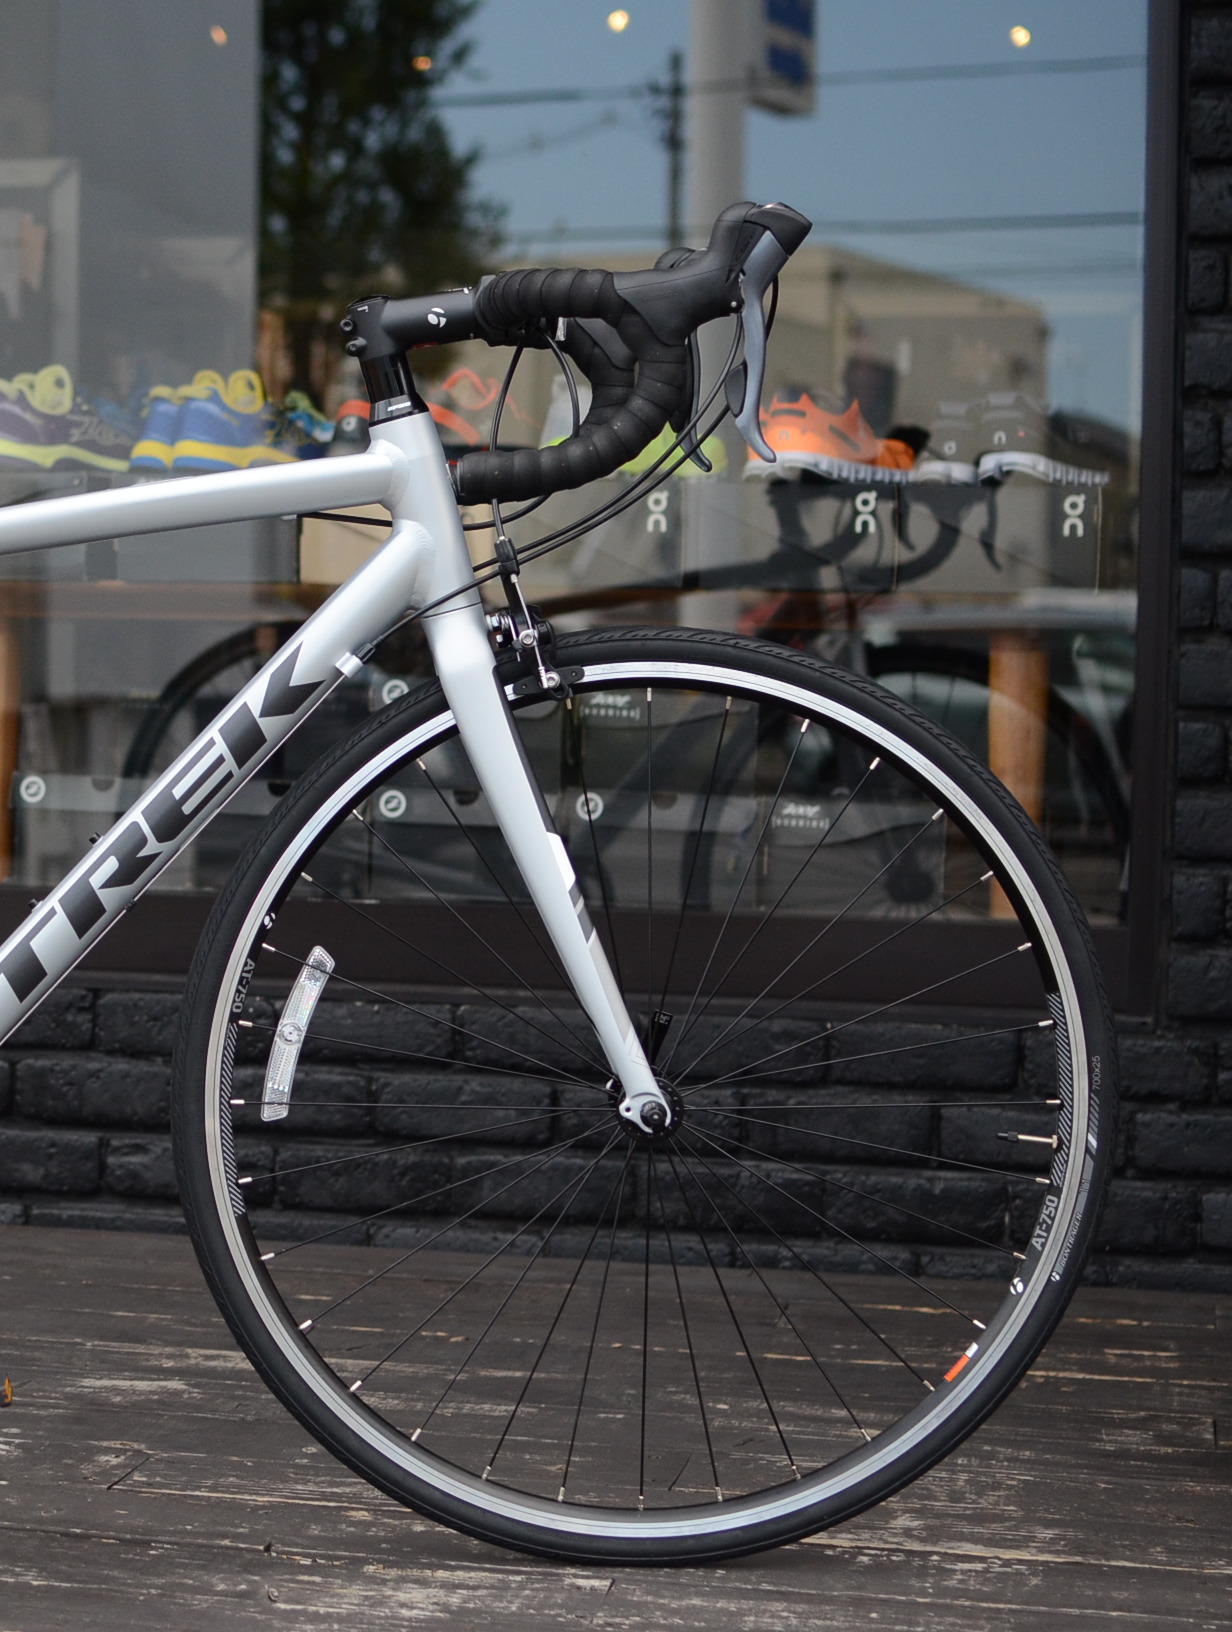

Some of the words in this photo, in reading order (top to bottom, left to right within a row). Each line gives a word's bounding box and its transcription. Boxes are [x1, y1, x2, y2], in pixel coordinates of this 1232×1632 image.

[232, 958, 256, 1013] AT-750
[1092, 1055, 1101, 1090] 700x25
[1031, 1195, 1059, 1252] AT-750
[1059, 1212, 1084, 1268] BONTRAGER
